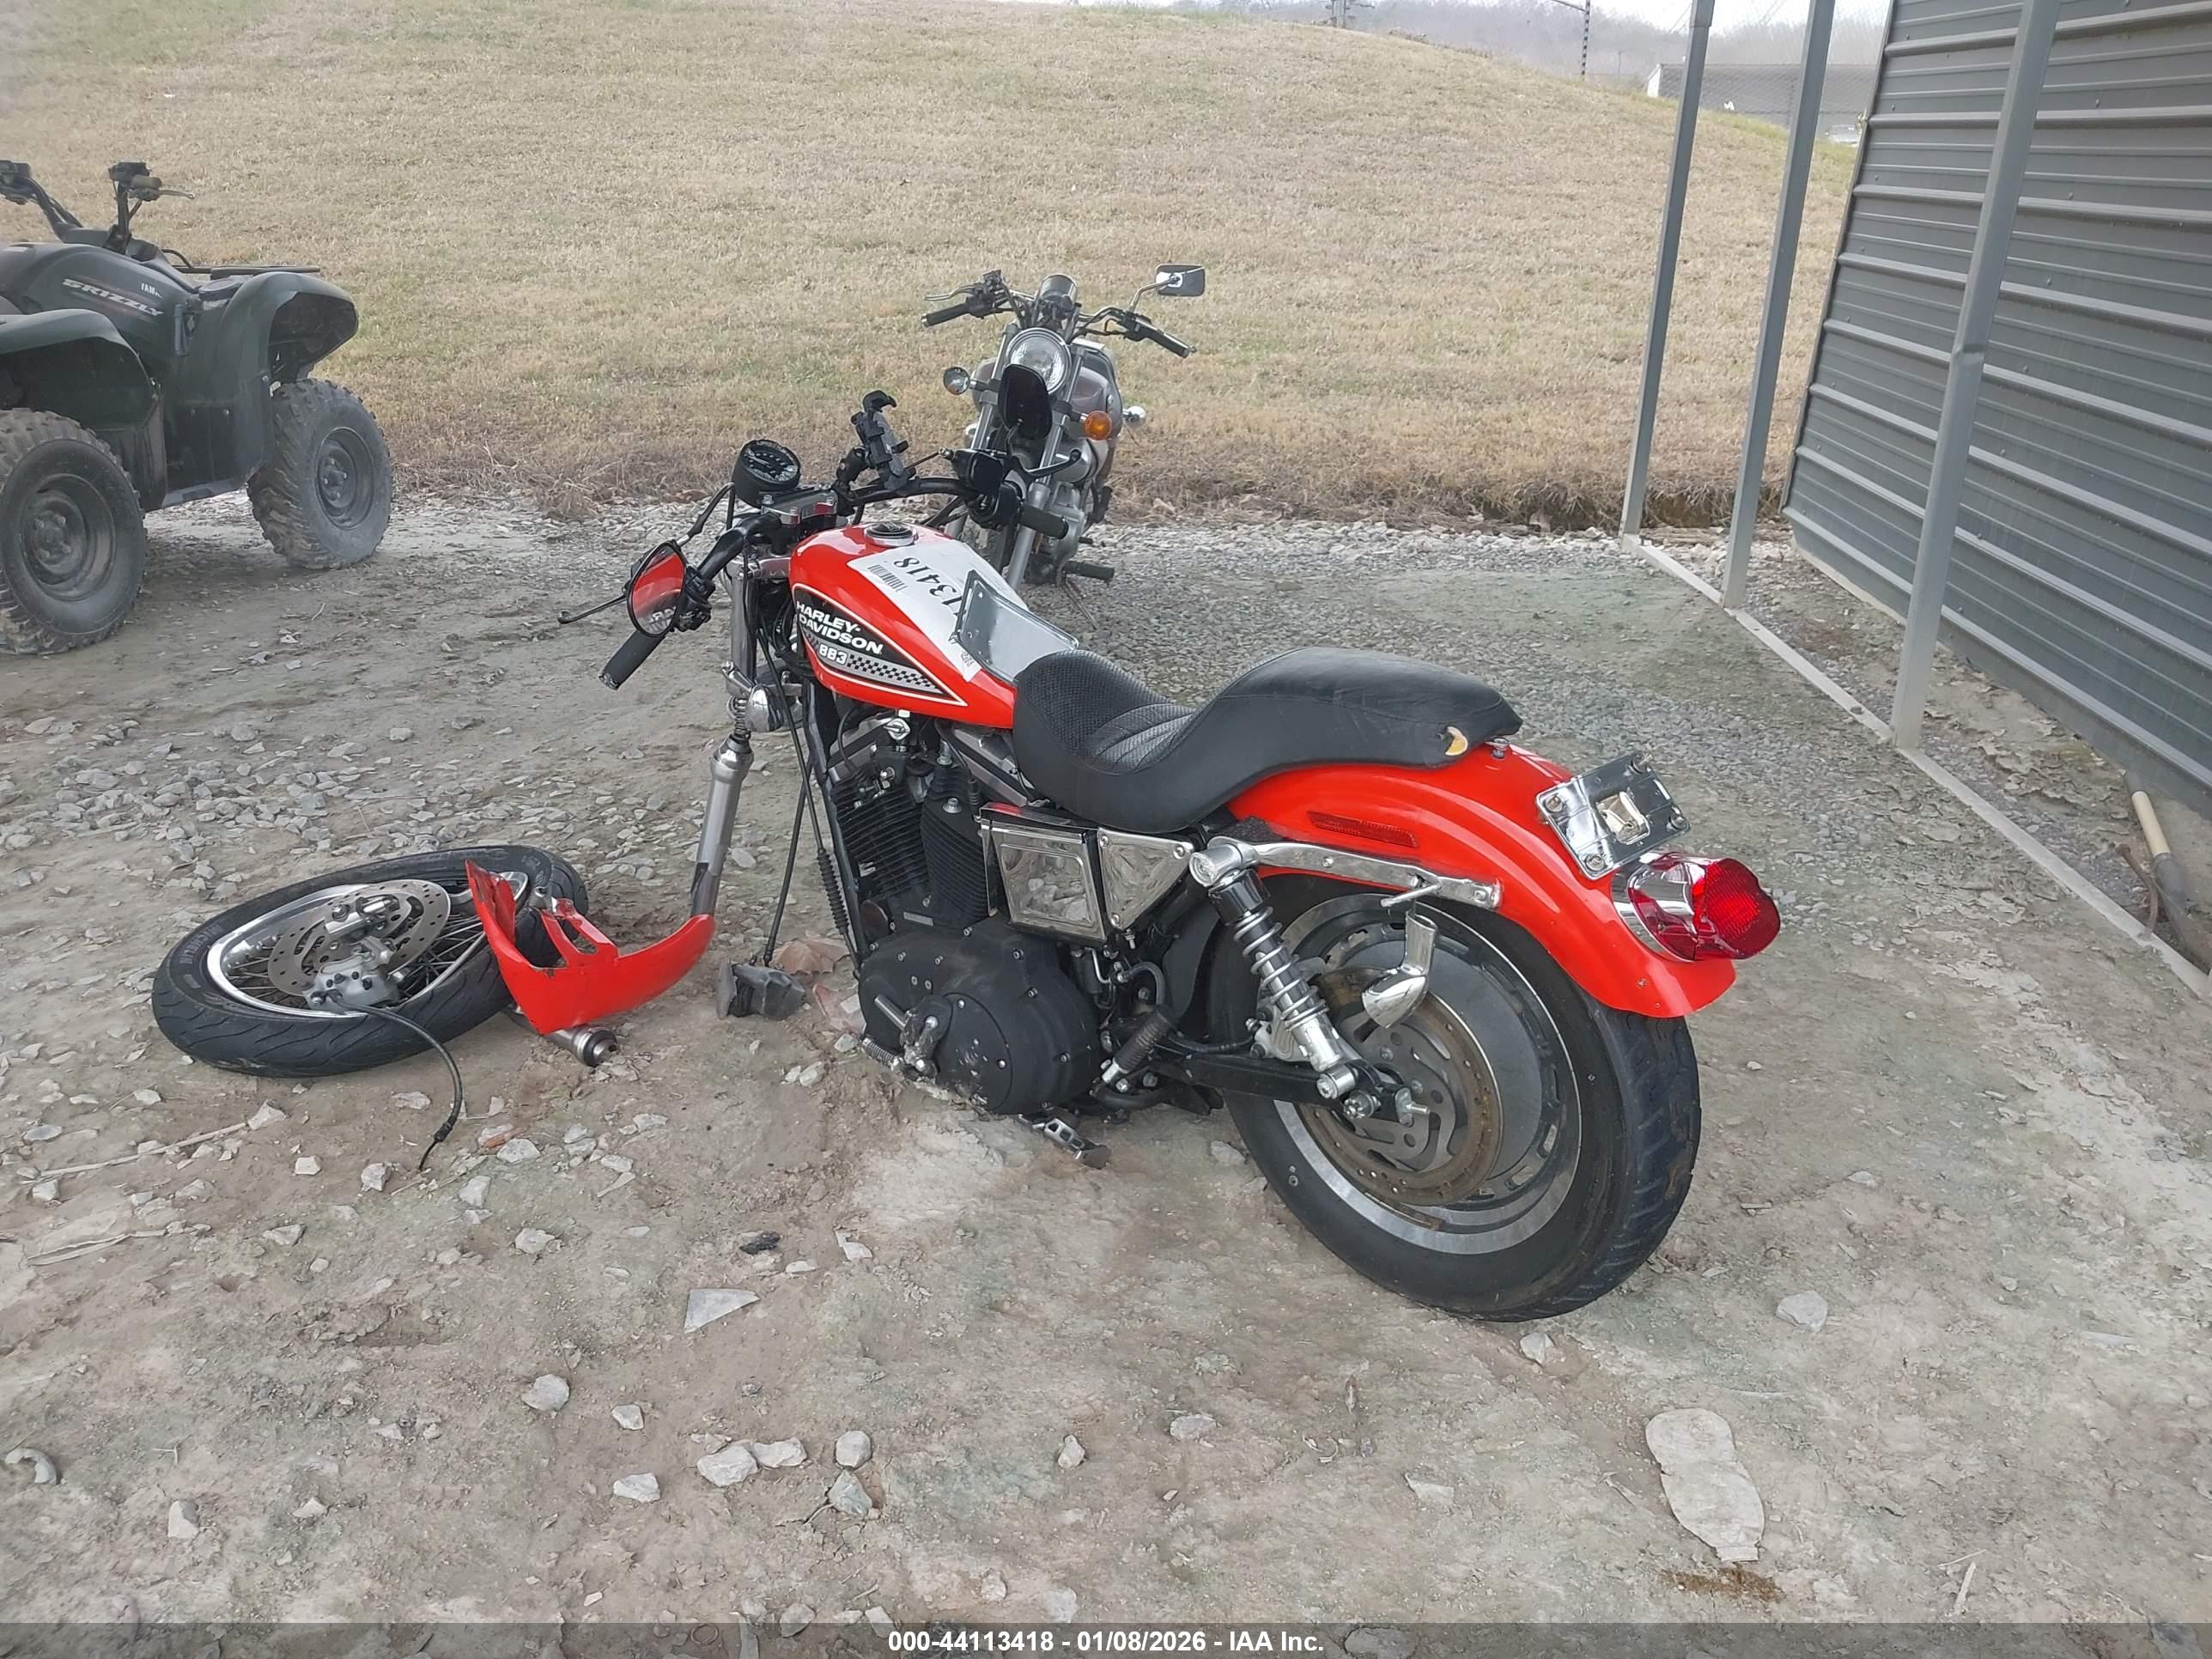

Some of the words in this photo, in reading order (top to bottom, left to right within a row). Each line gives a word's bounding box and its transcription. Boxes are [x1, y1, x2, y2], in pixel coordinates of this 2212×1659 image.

[62, 278, 164, 316] GRIZZLY
[799, 613, 884, 654] DAVIDSON
[818, 643, 848, 665] 883
